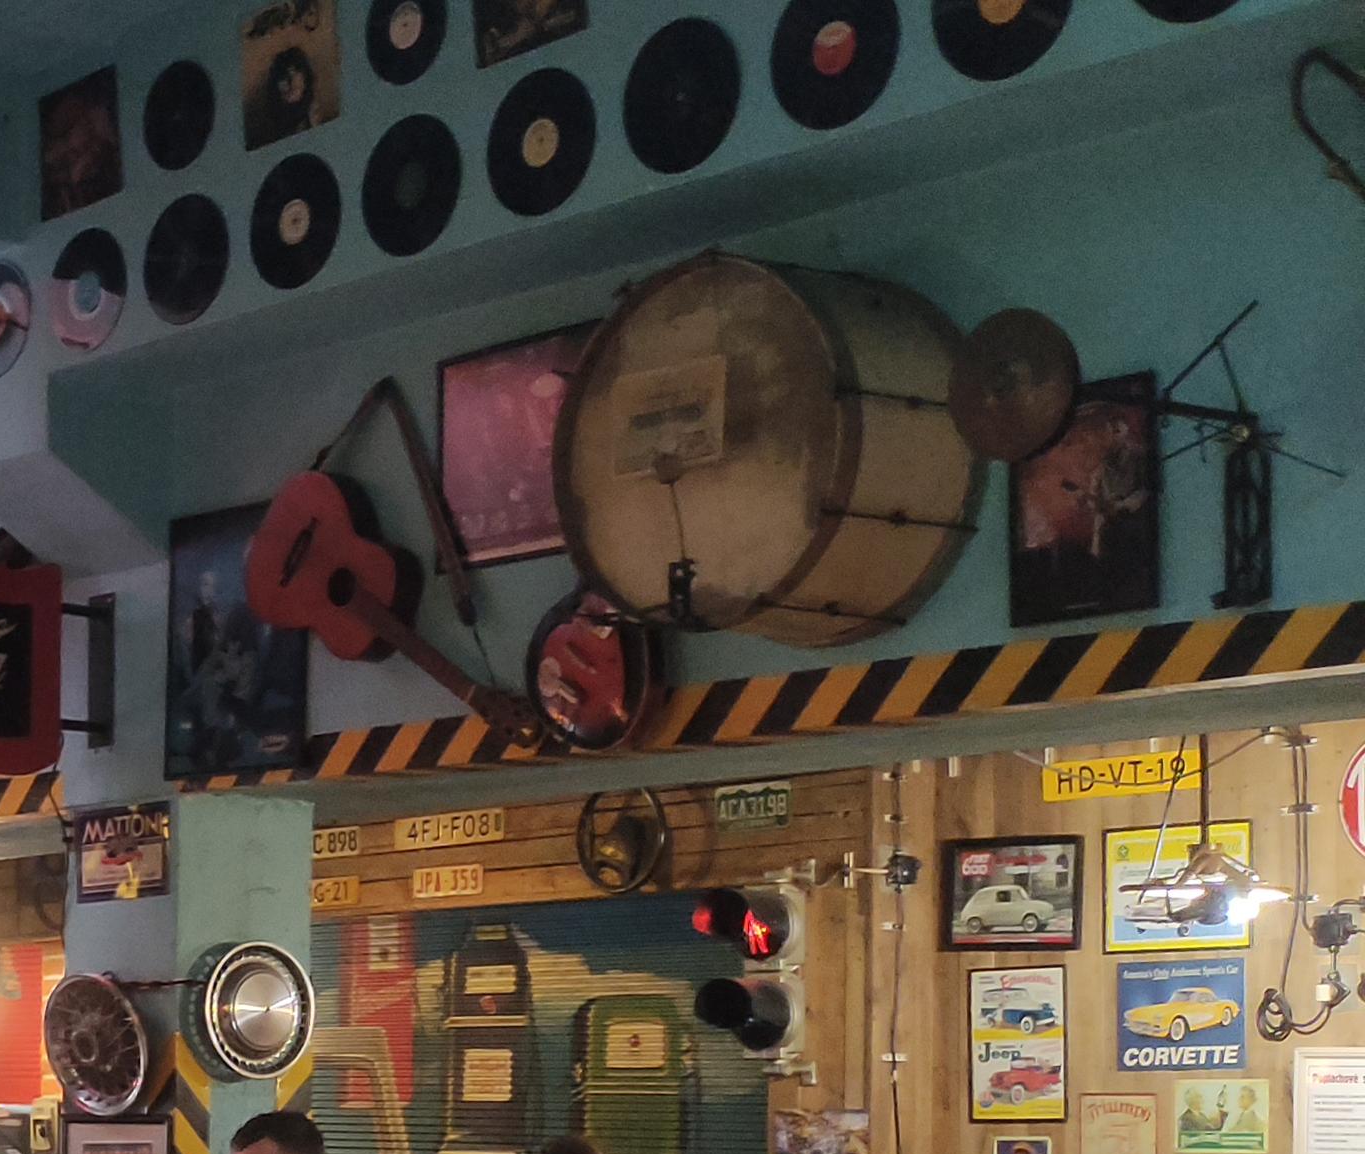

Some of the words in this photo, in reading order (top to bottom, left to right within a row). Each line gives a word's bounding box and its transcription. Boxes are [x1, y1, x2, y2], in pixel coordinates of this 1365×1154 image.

[1057, 755, 1186, 795] HD-VT-19
[406, 812, 490, 844] 4FJ-F08
[978, 1041, 1022, 1064] Jeep
[1123, 1043, 1241, 1068] CORVETTE
